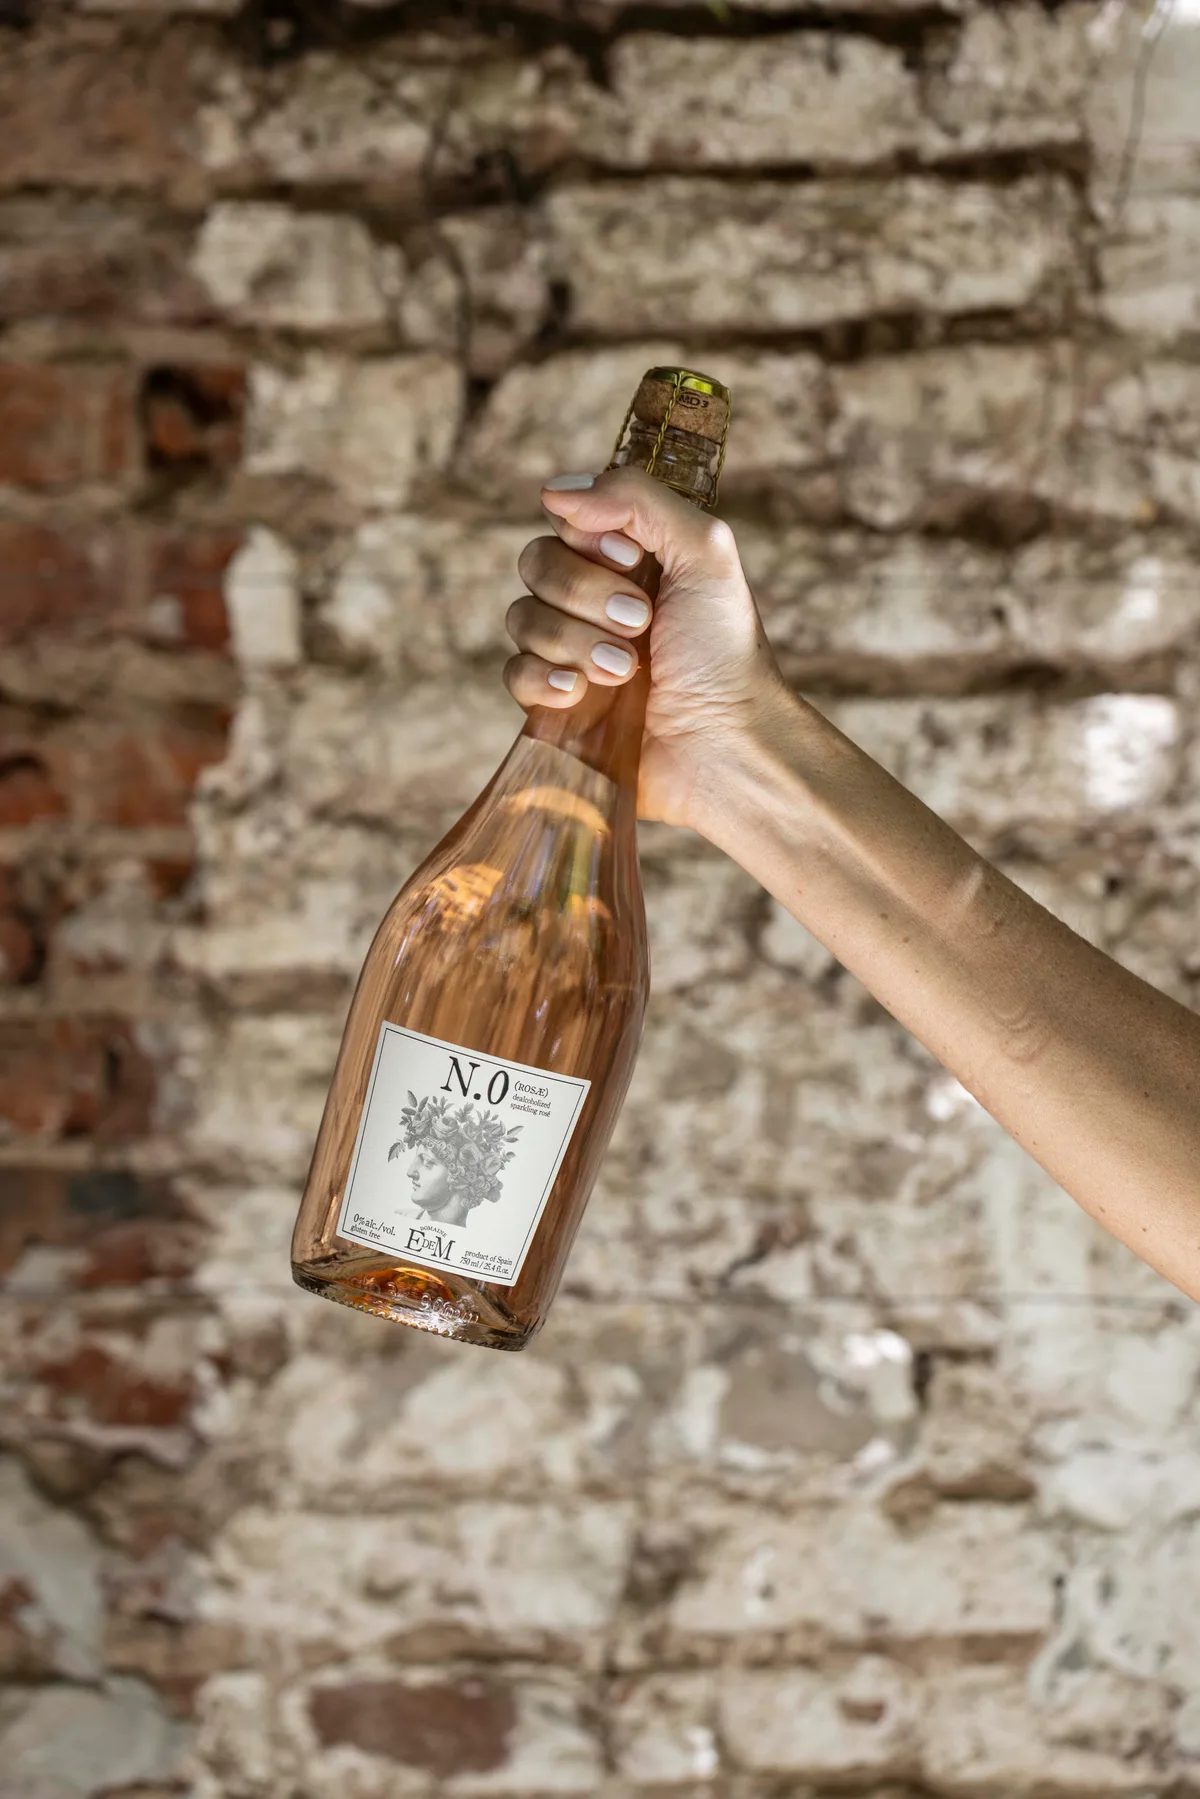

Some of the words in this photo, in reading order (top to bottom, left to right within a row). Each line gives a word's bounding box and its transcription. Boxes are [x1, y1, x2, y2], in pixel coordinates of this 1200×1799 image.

[512, 1093, 551, 1109] dealcoholized
[510, 1102, 538, 1115] sparkling
[538, 1109, 551, 1118] rosé
[350, 1224, 368, 1236] gluten
[368, 1230, 381, 1240] free
[420, 1225, 447, 1238] DOMAINE
[460, 1256, 471, 1265] 750
[471, 1260, 479, 1268] ml
[483, 1262, 496, 1271] 25.4
[465, 1250, 489, 1261] product
[489, 1255, 497, 1263] of
[496, 1255, 513, 1266] Spain
